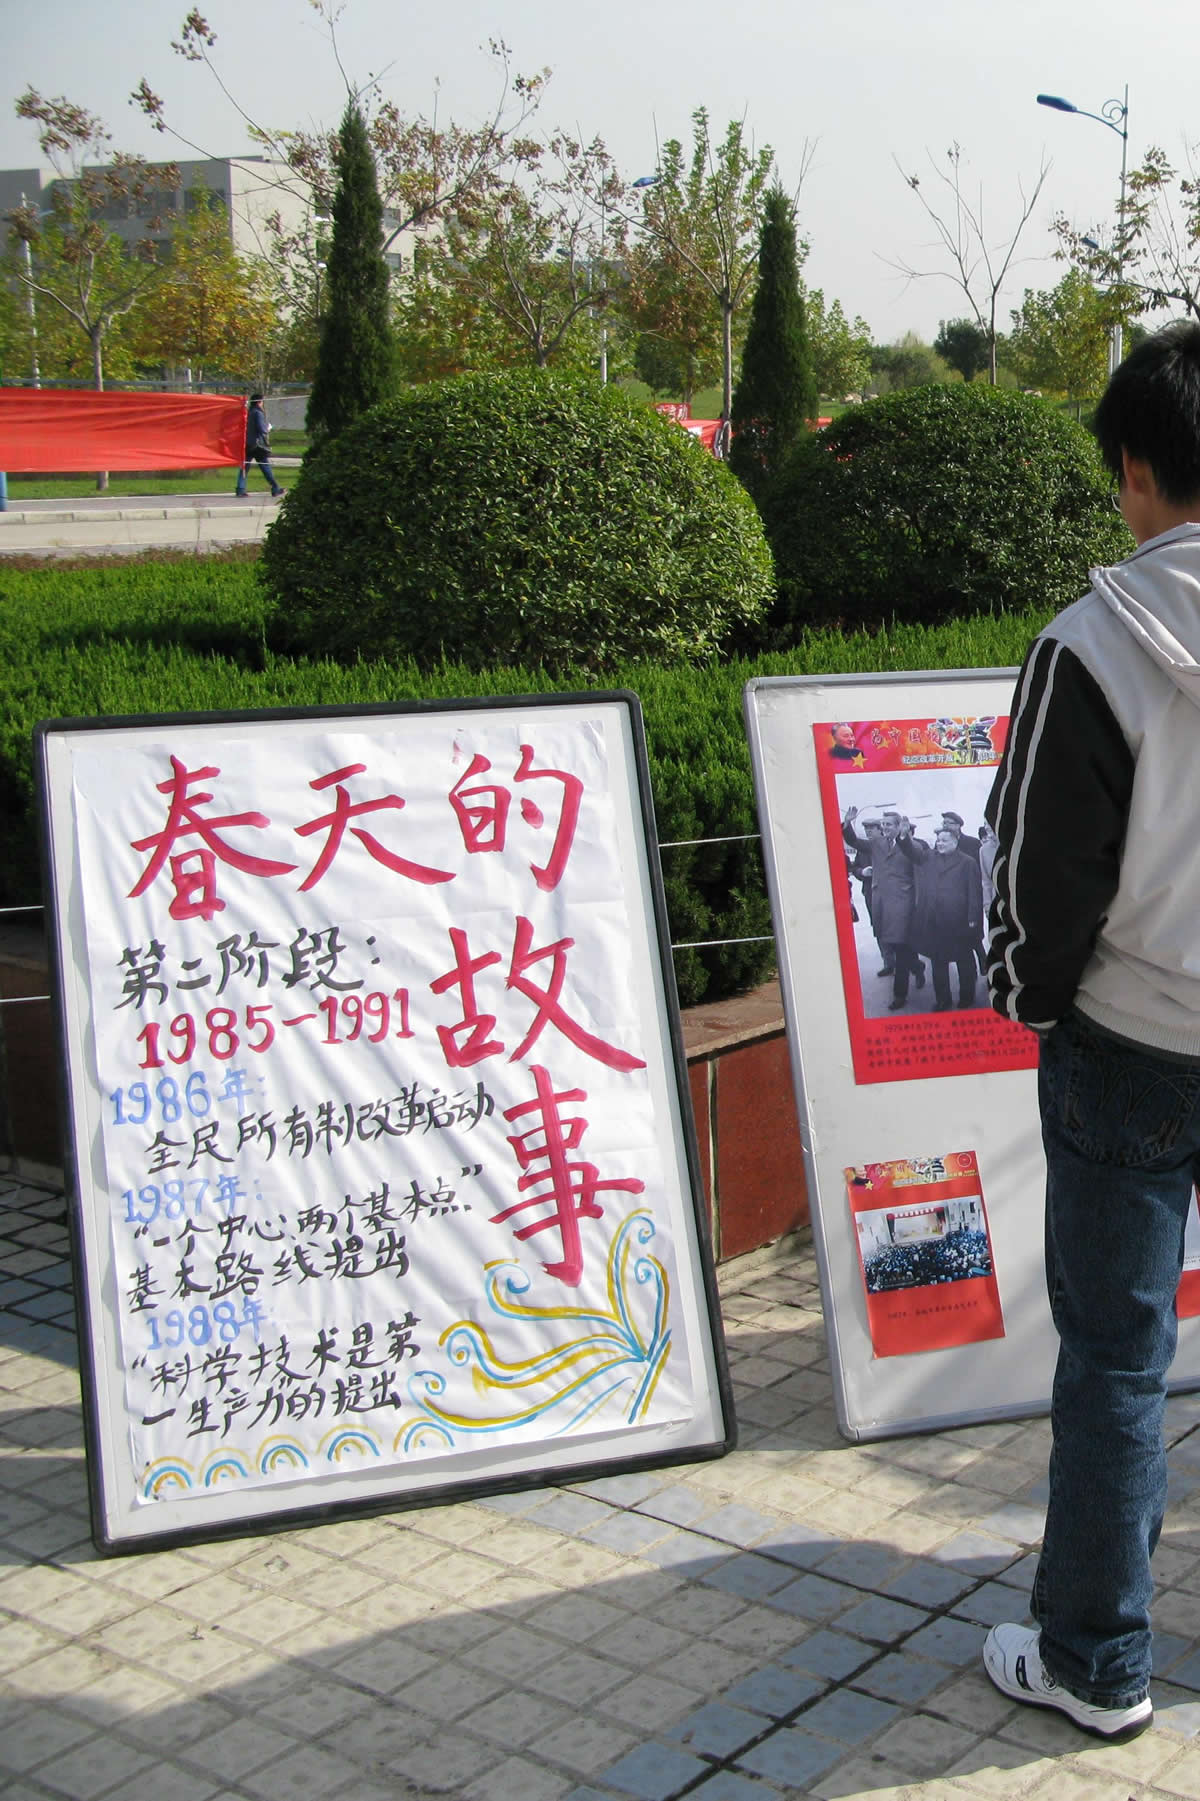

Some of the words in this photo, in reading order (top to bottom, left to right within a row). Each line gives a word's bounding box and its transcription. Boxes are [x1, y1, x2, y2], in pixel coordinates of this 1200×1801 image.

[127, 744, 584, 921] 春天的
[145, 1080, 496, 1174] 全民所有制改革启动
[430, 914, 648, 1287] 故事
[128, 1234, 412, 1314] 基本路线提出
